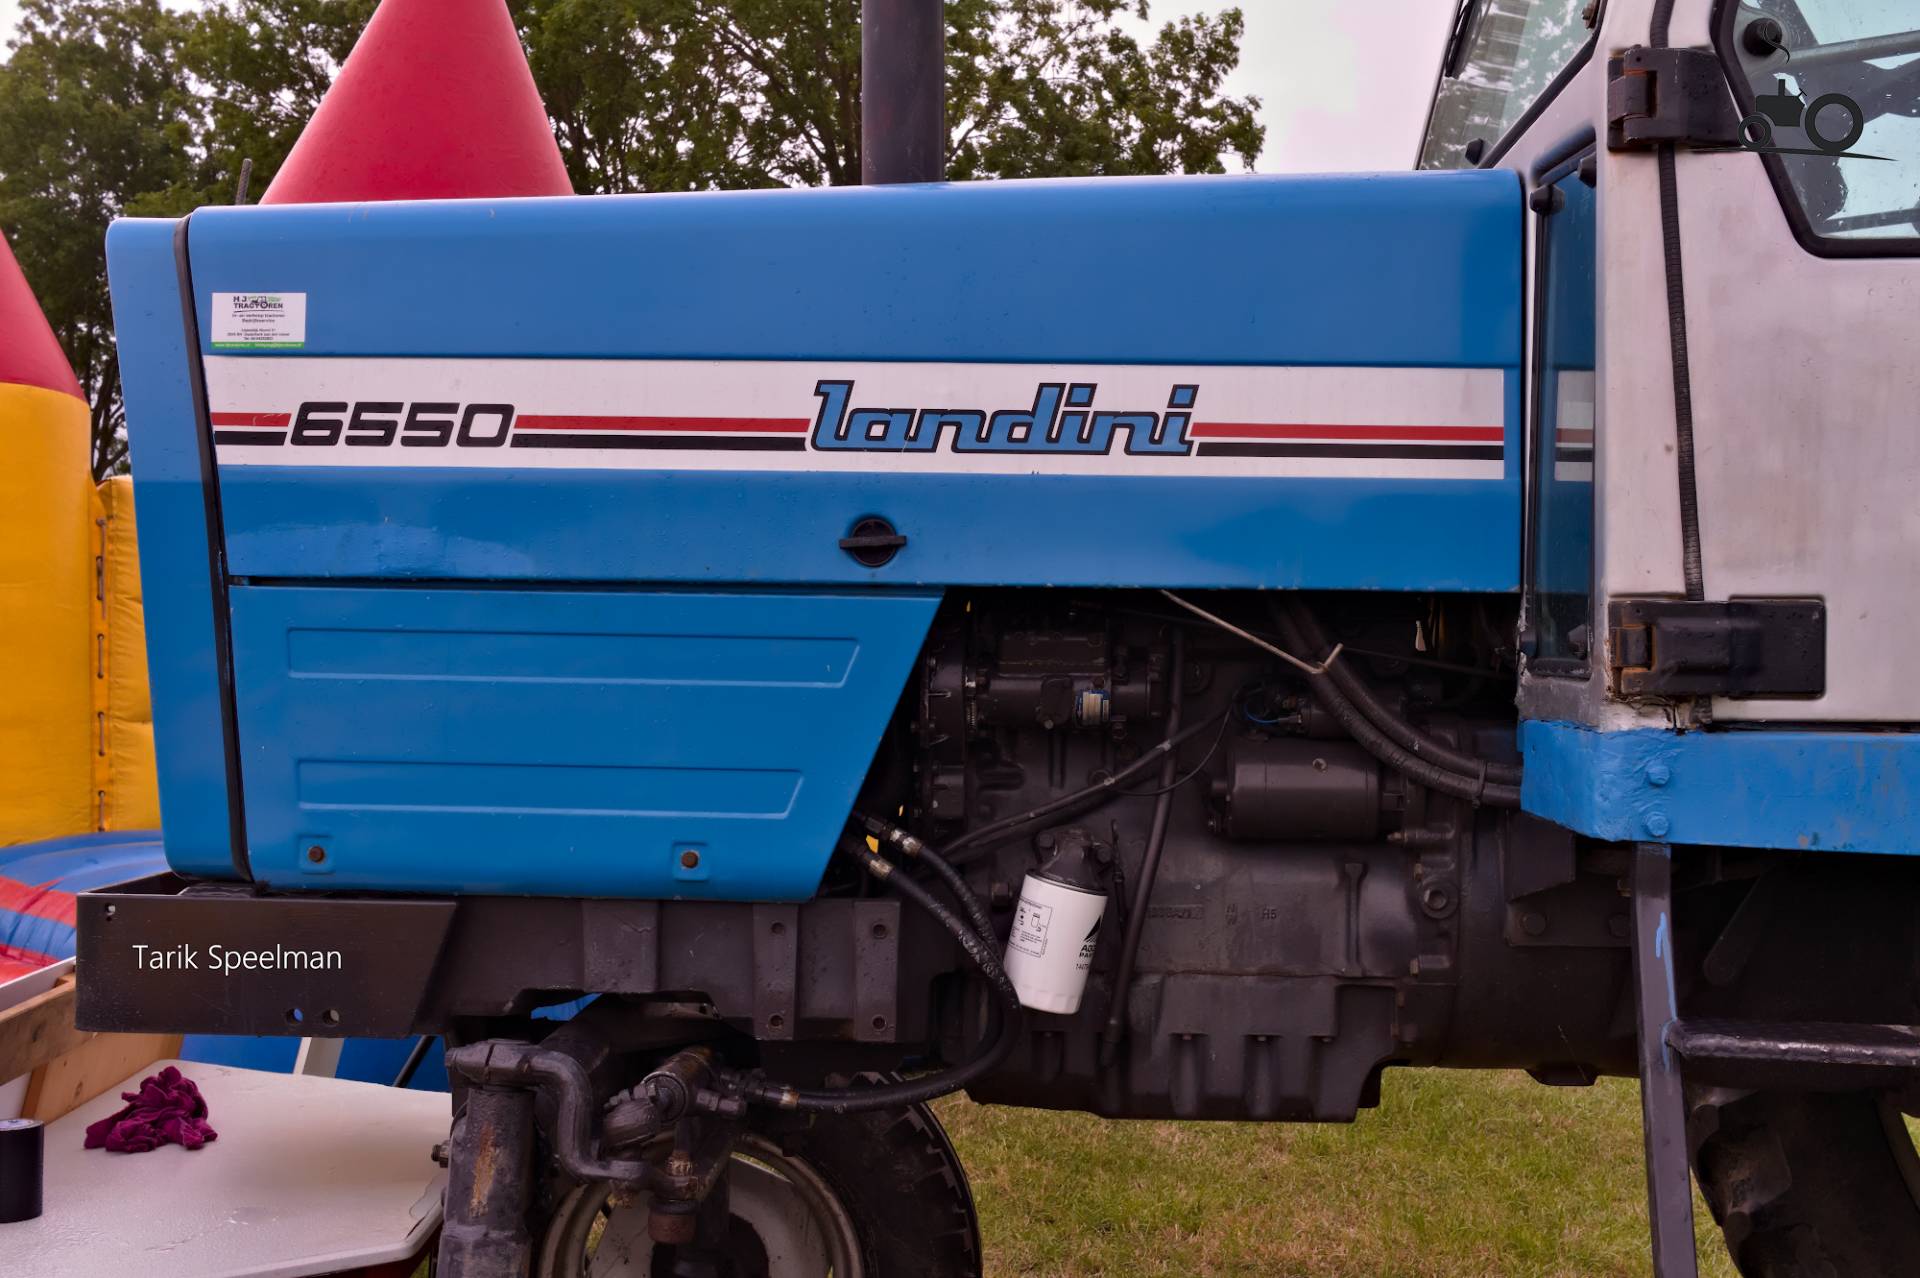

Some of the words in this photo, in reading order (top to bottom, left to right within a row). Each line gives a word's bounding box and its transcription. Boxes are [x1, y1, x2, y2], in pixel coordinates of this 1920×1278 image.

[233, 302, 284, 310] TRACTOREN
[290, 402, 515, 449] 6550
[811, 379, 1200, 457] landini
